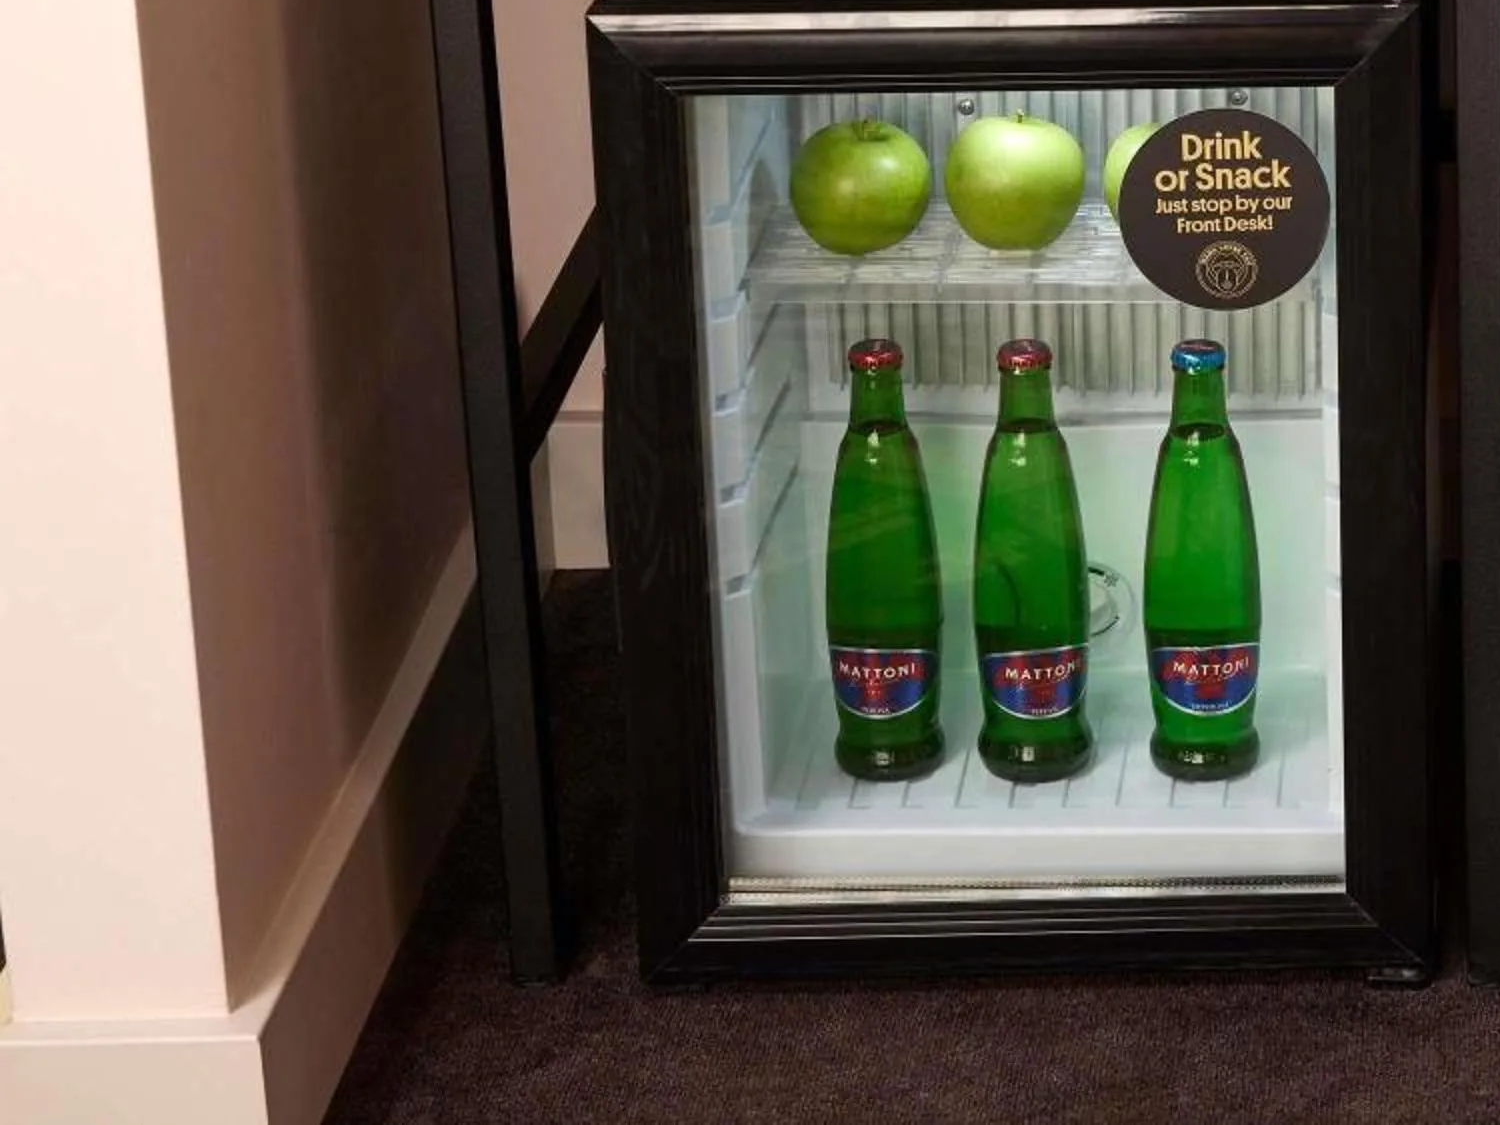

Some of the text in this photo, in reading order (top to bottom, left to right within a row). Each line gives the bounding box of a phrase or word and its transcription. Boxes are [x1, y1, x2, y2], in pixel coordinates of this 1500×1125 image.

[1181, 131, 1264, 162] Drink
[1155, 160, 1292, 192] or Snack
[1155, 194, 1293, 216] Just stop by our
[1177, 215, 1274, 234] Front Desk!
[837, 660, 916, 680] MATTONI
[1005, 658, 1080, 680] MATTON
[1172, 655, 1250, 676] MATTONI
